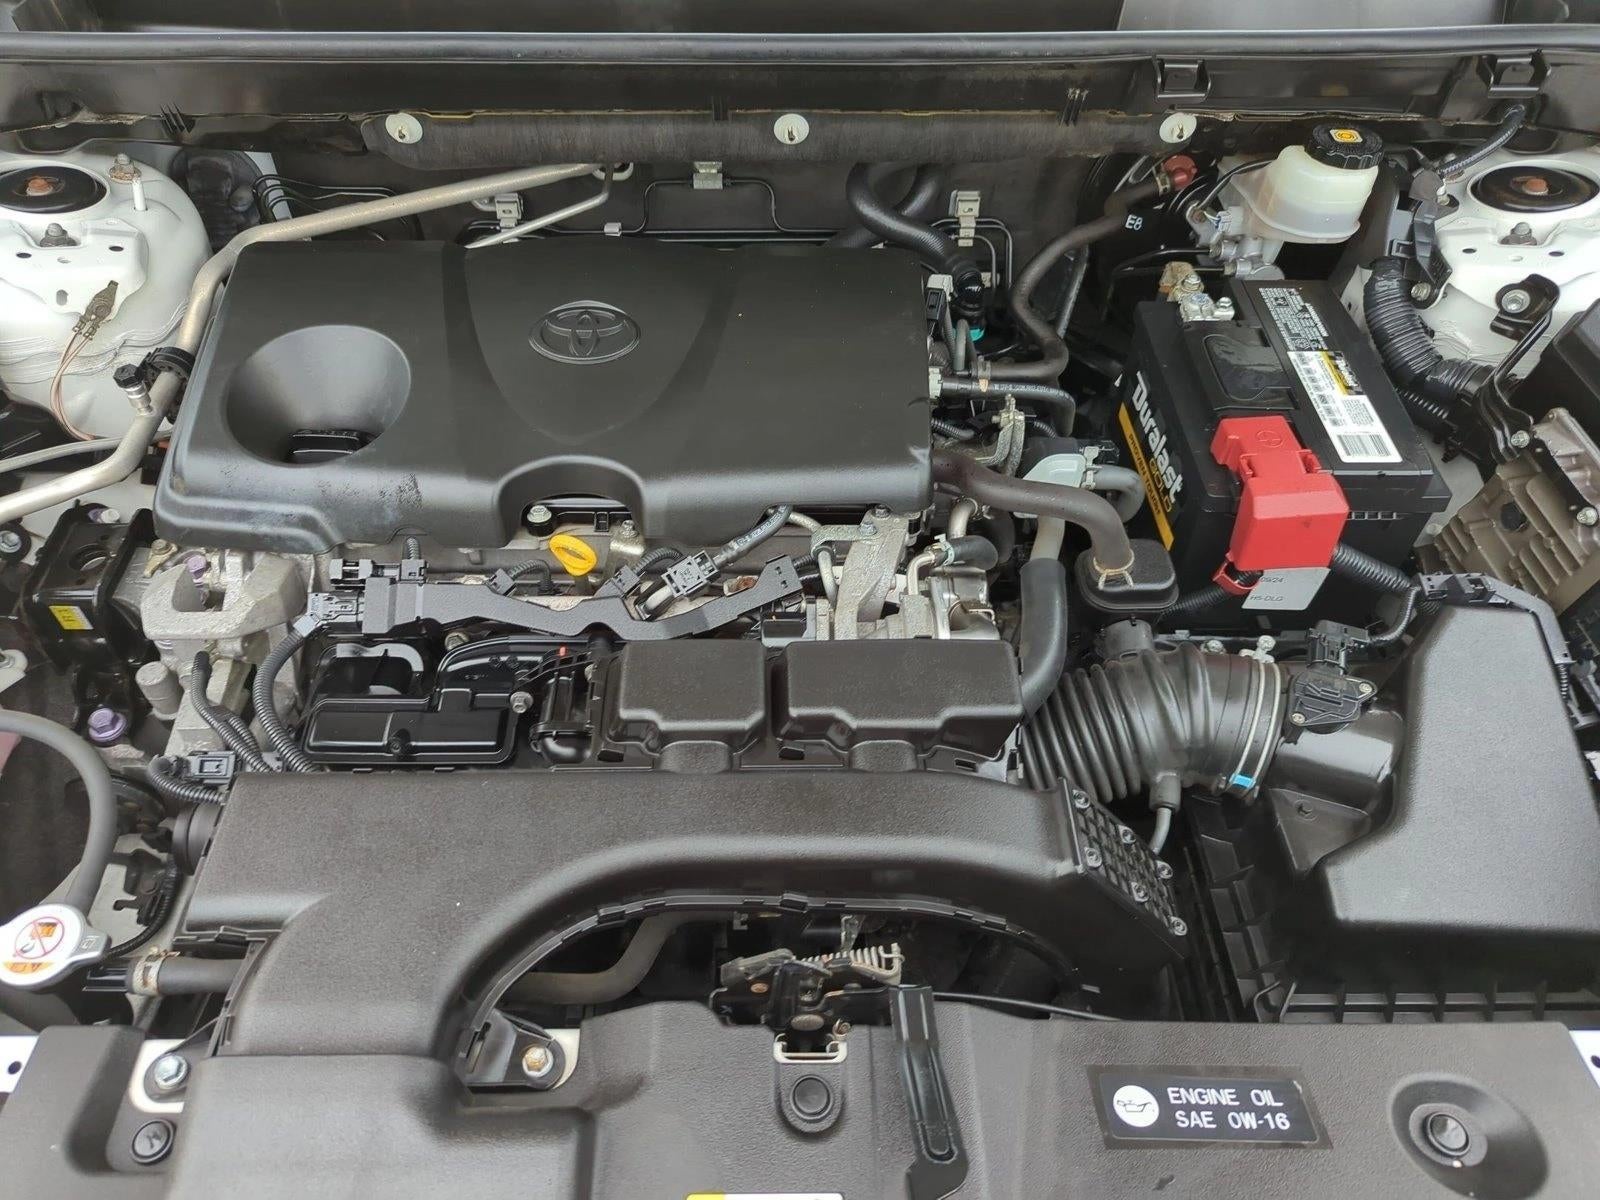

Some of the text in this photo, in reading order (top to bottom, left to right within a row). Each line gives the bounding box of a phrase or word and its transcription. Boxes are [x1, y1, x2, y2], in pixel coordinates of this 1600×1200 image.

[1125, 214, 1143, 231] E8
[1132, 370, 1183, 504] Duralast
[1167, 1086, 1284, 1107] ENGINE OIL
[1175, 1110, 1291, 1131] SAE 0W-16
